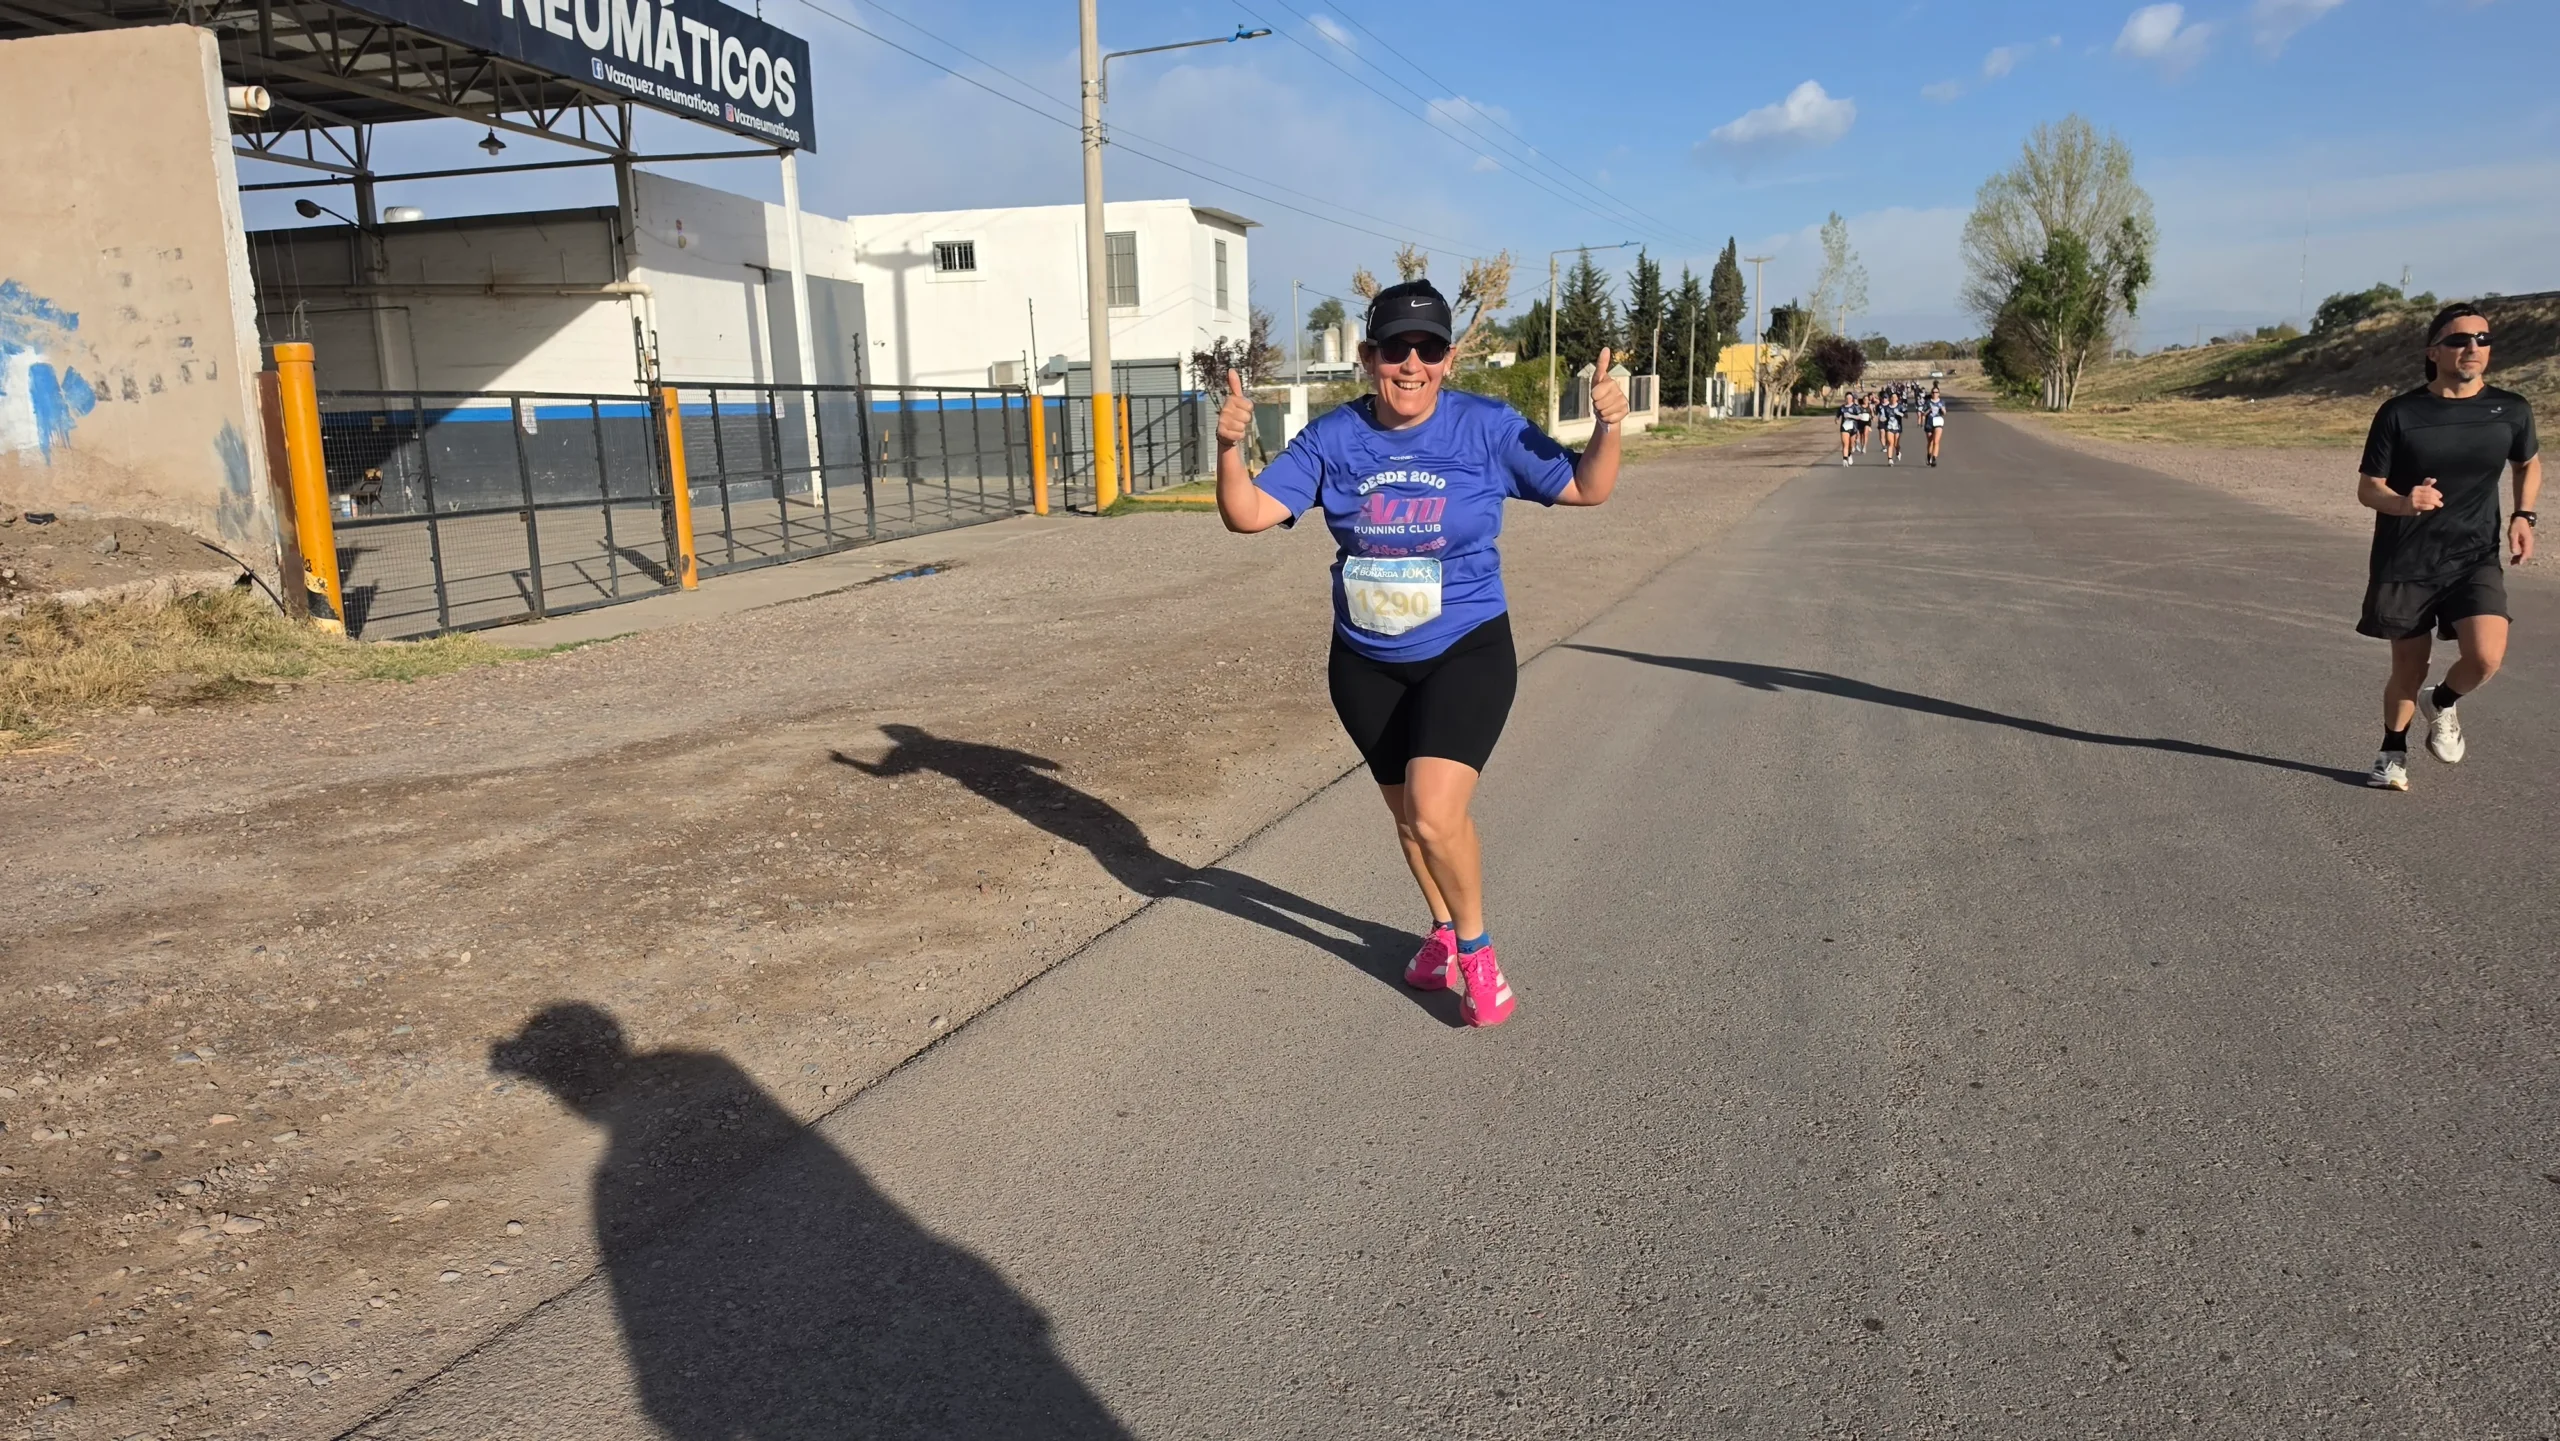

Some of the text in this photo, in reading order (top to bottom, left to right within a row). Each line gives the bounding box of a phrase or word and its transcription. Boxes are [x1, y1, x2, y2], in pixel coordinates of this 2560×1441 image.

[604, 63, 720, 117] Vazquez neumaticos
[733, 107, 800, 142] Vazneumaticos
[1358, 470, 1446, 495] DESDE 2010
[1354, 523, 1442, 535] RUNNING CLUB
[1360, 567, 1425, 579] BONARDA 10K
[1356, 588, 1429, 618] 1290
